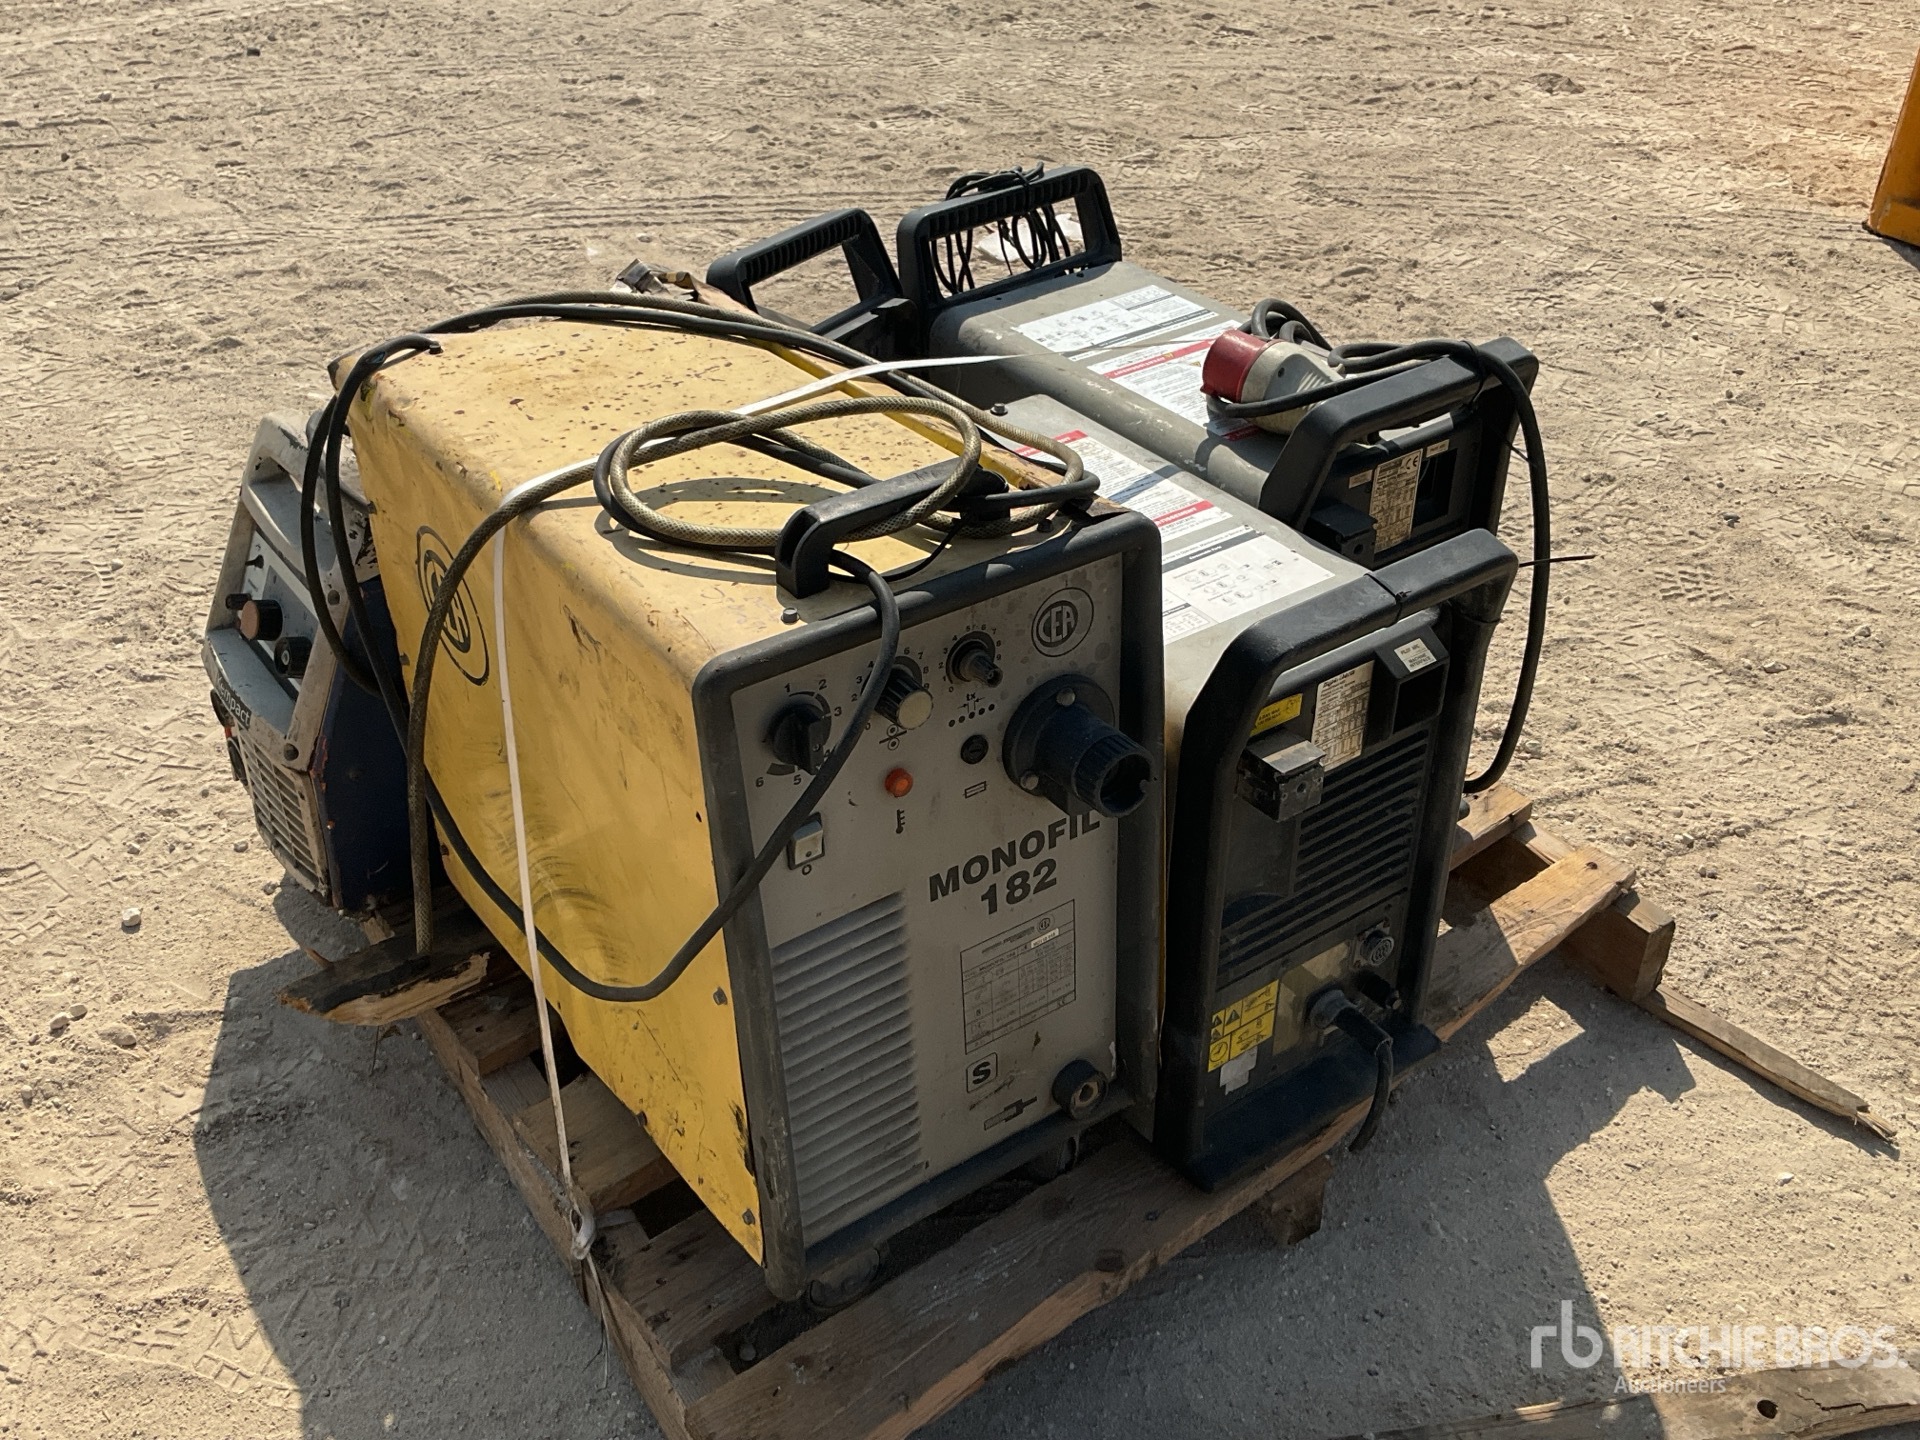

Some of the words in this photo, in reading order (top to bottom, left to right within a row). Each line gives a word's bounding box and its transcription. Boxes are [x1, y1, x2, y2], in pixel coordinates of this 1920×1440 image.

[784, 683, 791, 693] 1
[818, 678, 828, 691] 2
[834, 706, 842, 717] 3
[755, 776, 764, 787] 6
[793, 774, 802, 785] 5
[929, 809, 1100, 902] MONOFIL
[980, 858, 1057, 915] 182
[972, 1061, 991, 1085] S
